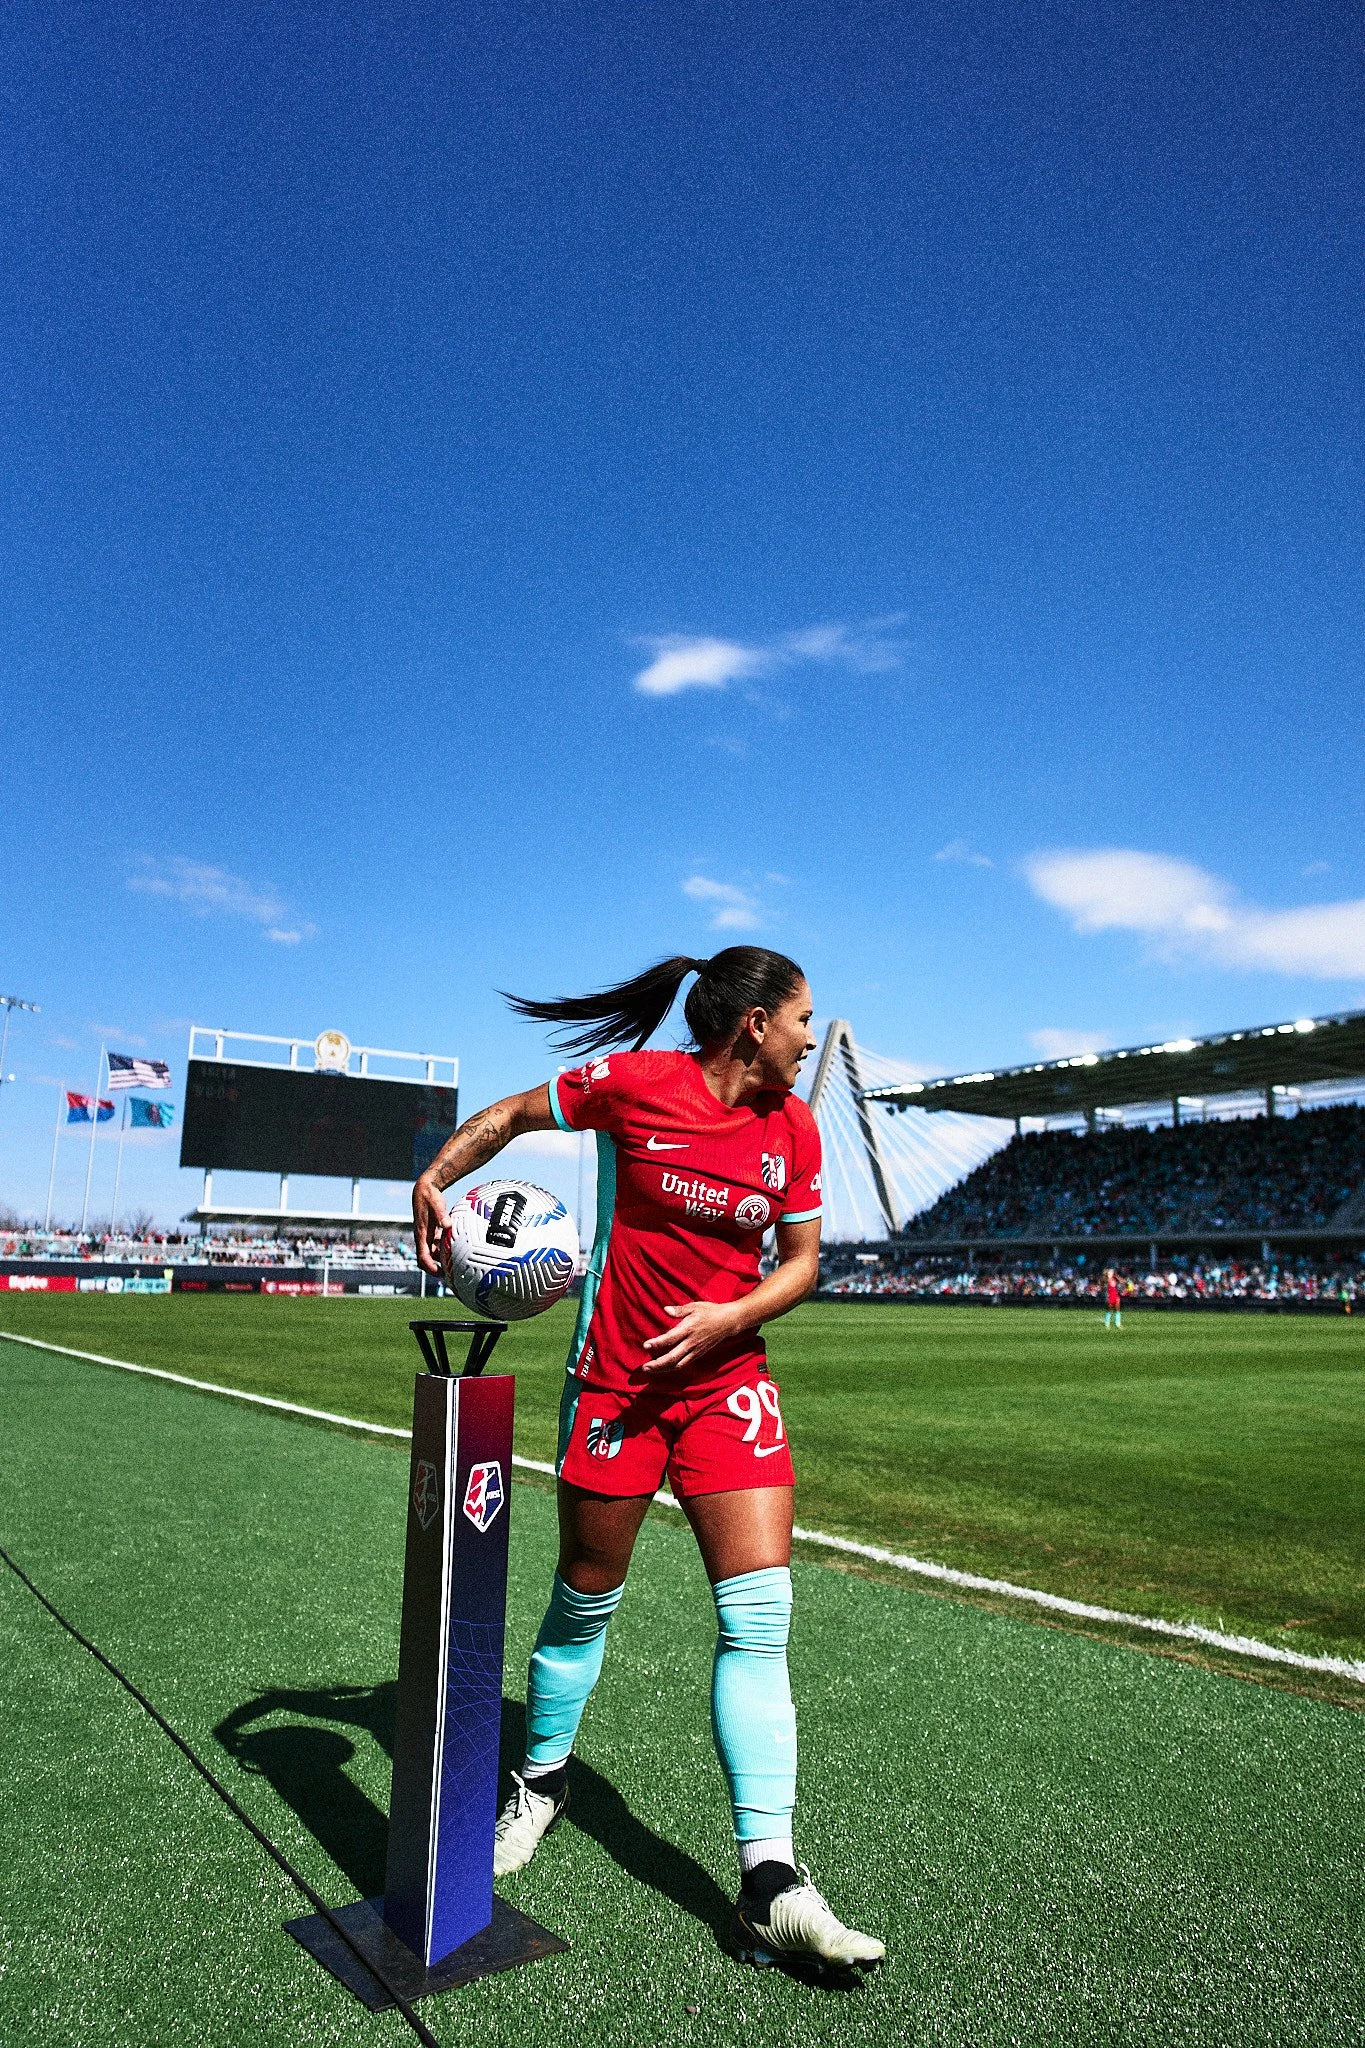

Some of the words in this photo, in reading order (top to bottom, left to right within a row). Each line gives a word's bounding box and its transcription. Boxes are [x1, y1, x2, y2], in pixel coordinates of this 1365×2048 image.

[661, 1172, 730, 1206] United
[684, 1199, 725, 1223] Way
[727, 1380, 784, 1442] 99
